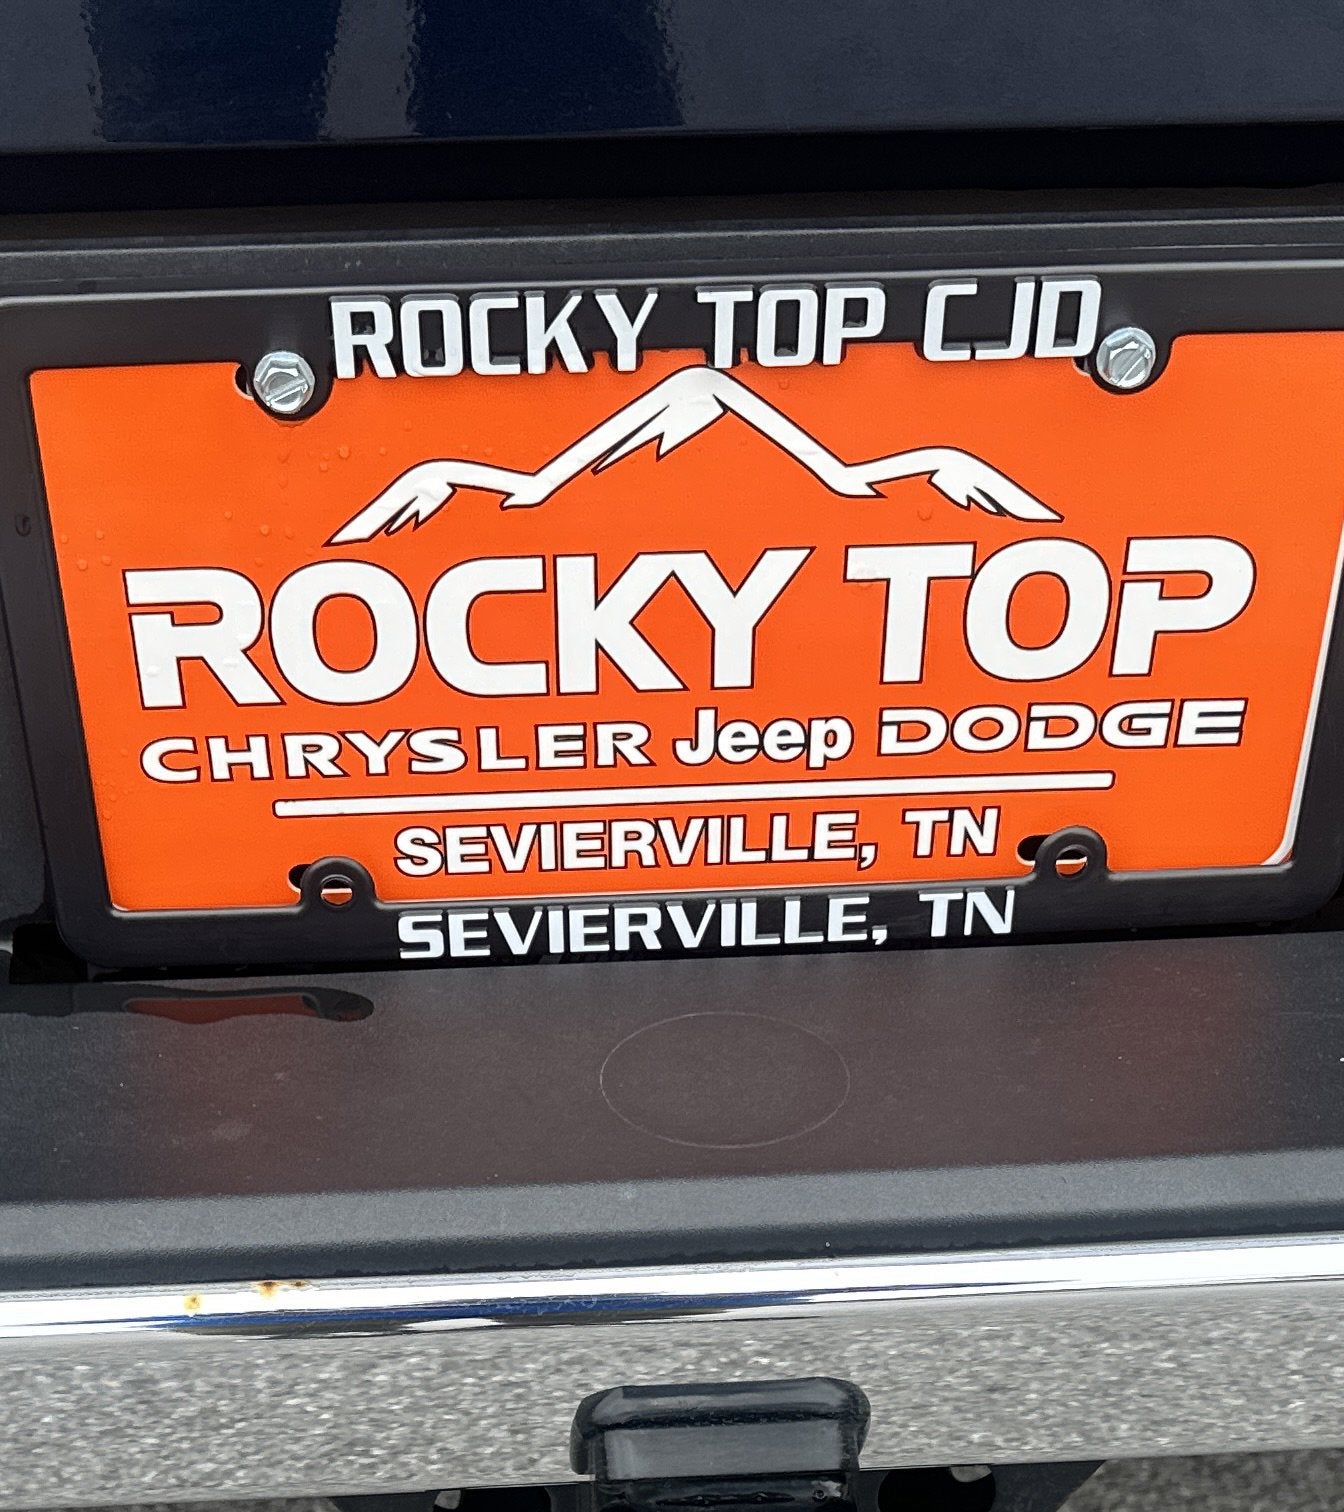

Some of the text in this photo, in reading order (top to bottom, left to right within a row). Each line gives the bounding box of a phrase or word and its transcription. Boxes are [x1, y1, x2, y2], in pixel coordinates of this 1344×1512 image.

[330, 275, 1103, 379] ROCKY TOP CJD
[122, 534, 1258, 710] ROCKY TOP
[139, 697, 1249, 784] CHRYSLER Jeep DODGE
[393, 806, 1001, 878] SEVIERVILLE, TN
[398, 886, 1016, 961] SEVIERVILLE, TN
